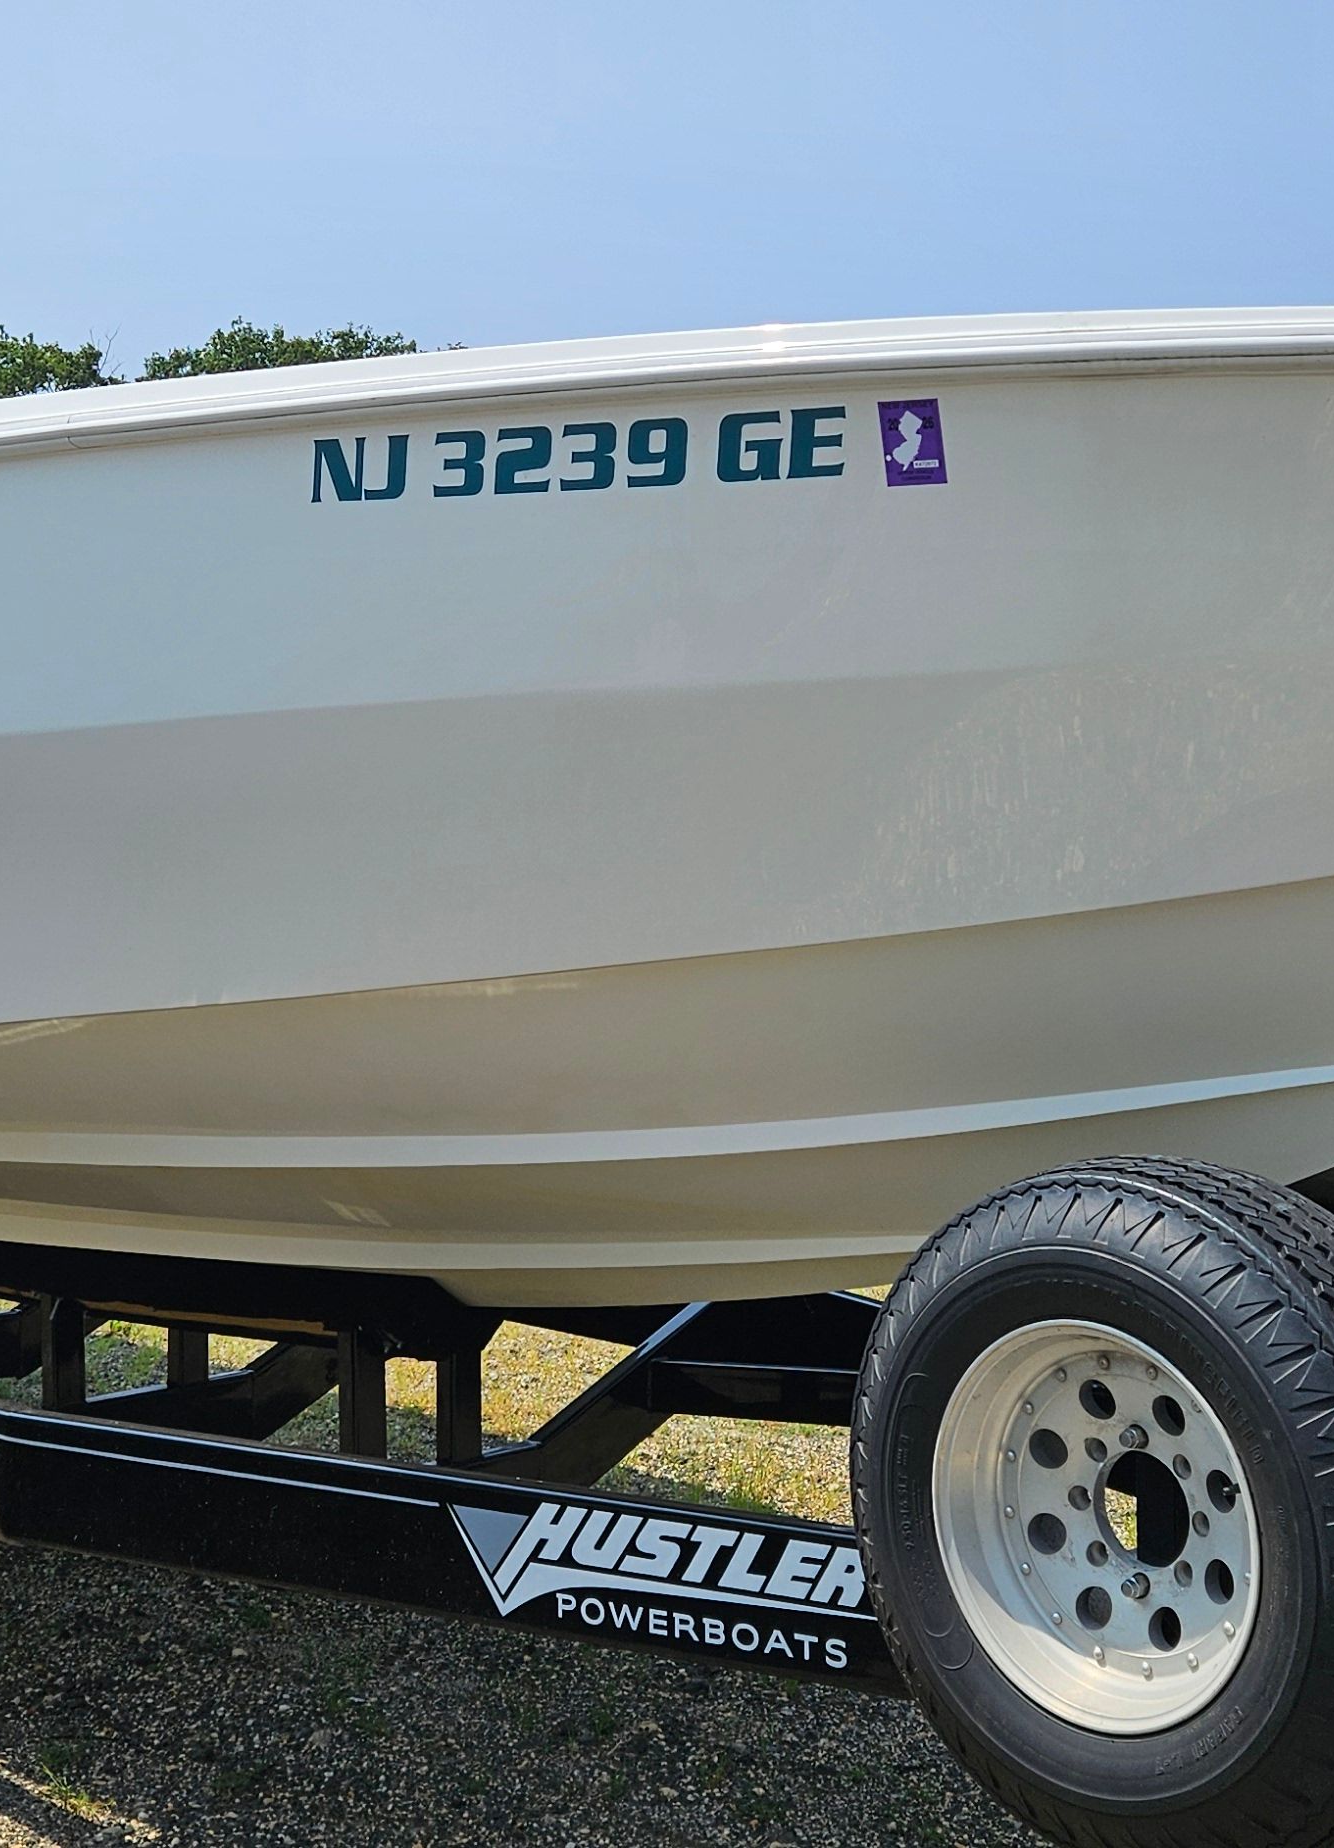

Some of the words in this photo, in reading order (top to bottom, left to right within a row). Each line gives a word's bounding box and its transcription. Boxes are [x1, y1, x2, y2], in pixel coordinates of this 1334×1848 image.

[311, 434, 410, 503] NJ
[432, 417, 689, 498] 3239
[717, 406, 847, 483] GE
[494, 1501, 868, 1608] HUSTLER
[555, 1593, 849, 1669] POWERBOATS
